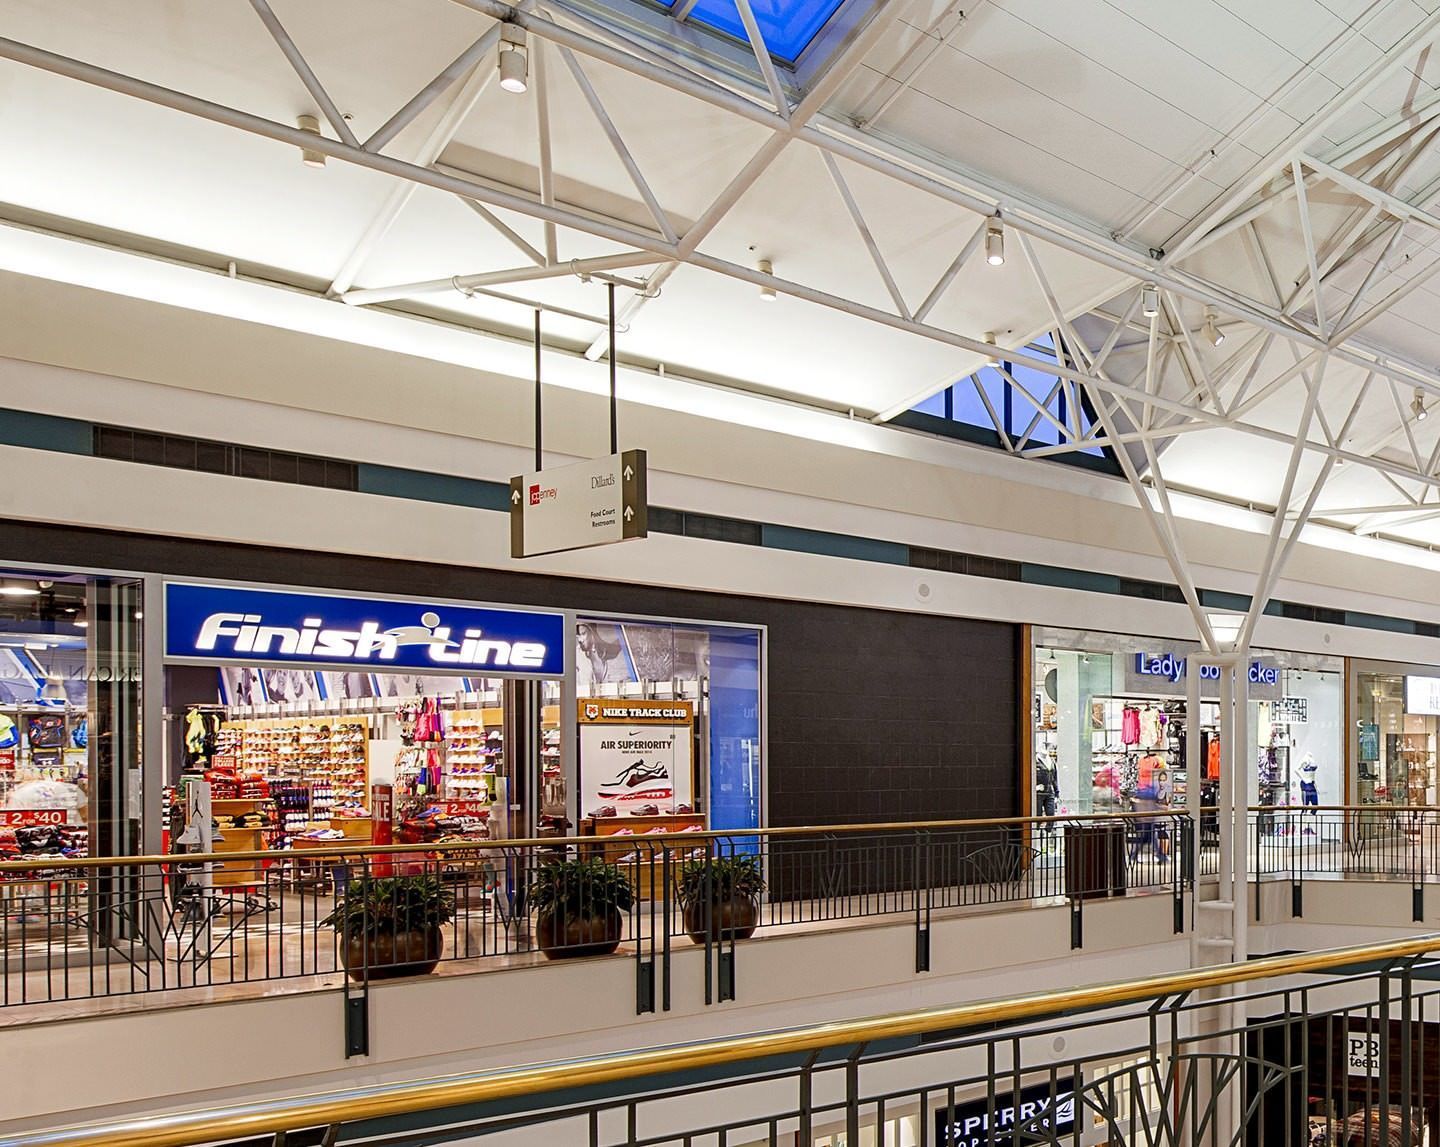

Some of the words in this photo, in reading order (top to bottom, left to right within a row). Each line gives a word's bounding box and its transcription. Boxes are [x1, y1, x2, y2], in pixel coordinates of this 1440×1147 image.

[591, 473, 616, 489] Dillard's
[590, 509, 602, 518] Food
[602, 508, 616, 517] Court
[591, 519, 616, 528] Restrooms
[195, 612, 398, 660] Finish
[1140, 652, 1183, 683] Lady
[602, 707, 628, 717] NIKE
[629, 708, 662, 718] TRACK
[662, 708, 687, 718] CLUB
[600, 740, 616, 750] AIR
[617, 740, 673, 750] SUPERIORITY
[451, 803, 458, 814] 2
[11, 813, 23, 825] 2
[34, 811, 62, 824] $40
[1349, 1039, 1379, 1058] PB
[1350, 1056, 1379, 1069] teen
